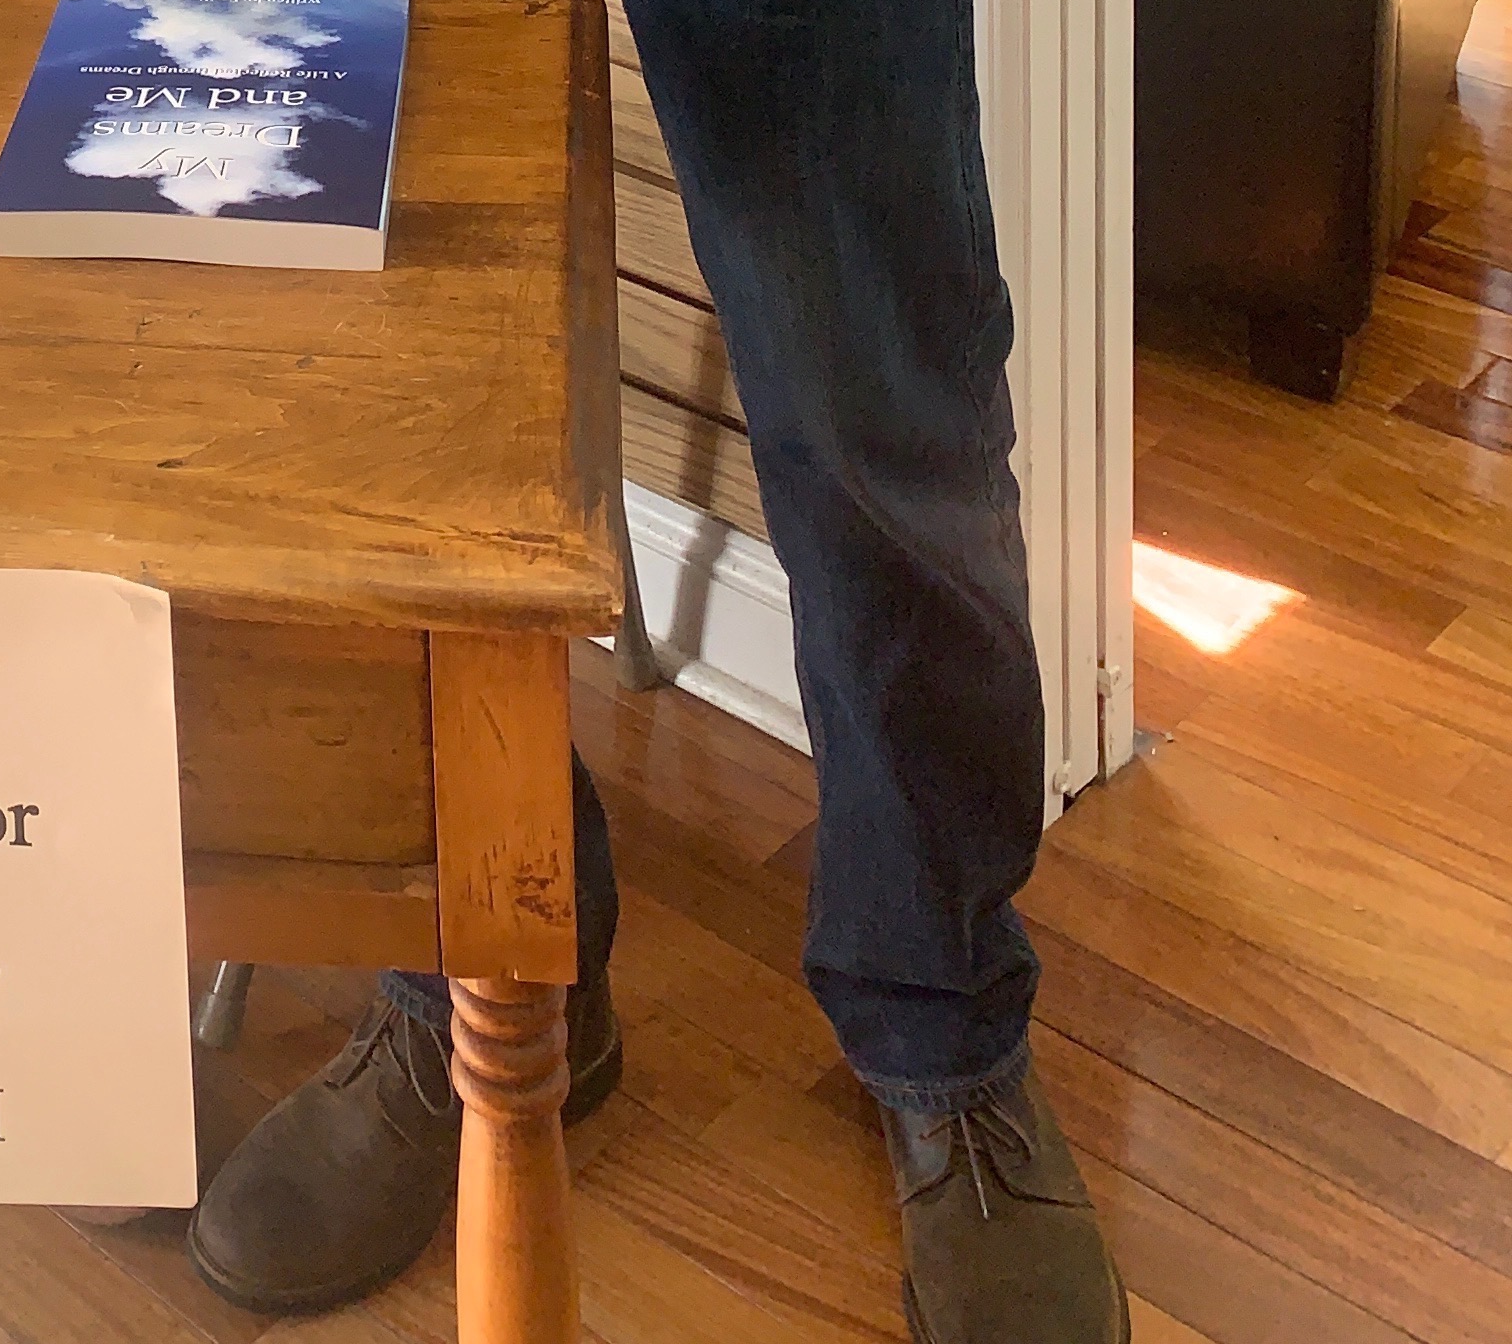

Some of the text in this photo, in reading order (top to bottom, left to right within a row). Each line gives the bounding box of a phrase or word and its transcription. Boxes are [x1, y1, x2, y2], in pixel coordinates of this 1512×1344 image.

[80, 65, 348, 80] A Life Reflected through Dreams
[105, 86, 309, 110] and Me
[93, 120, 302, 149] Dreams
[138, 147, 236, 181] My
